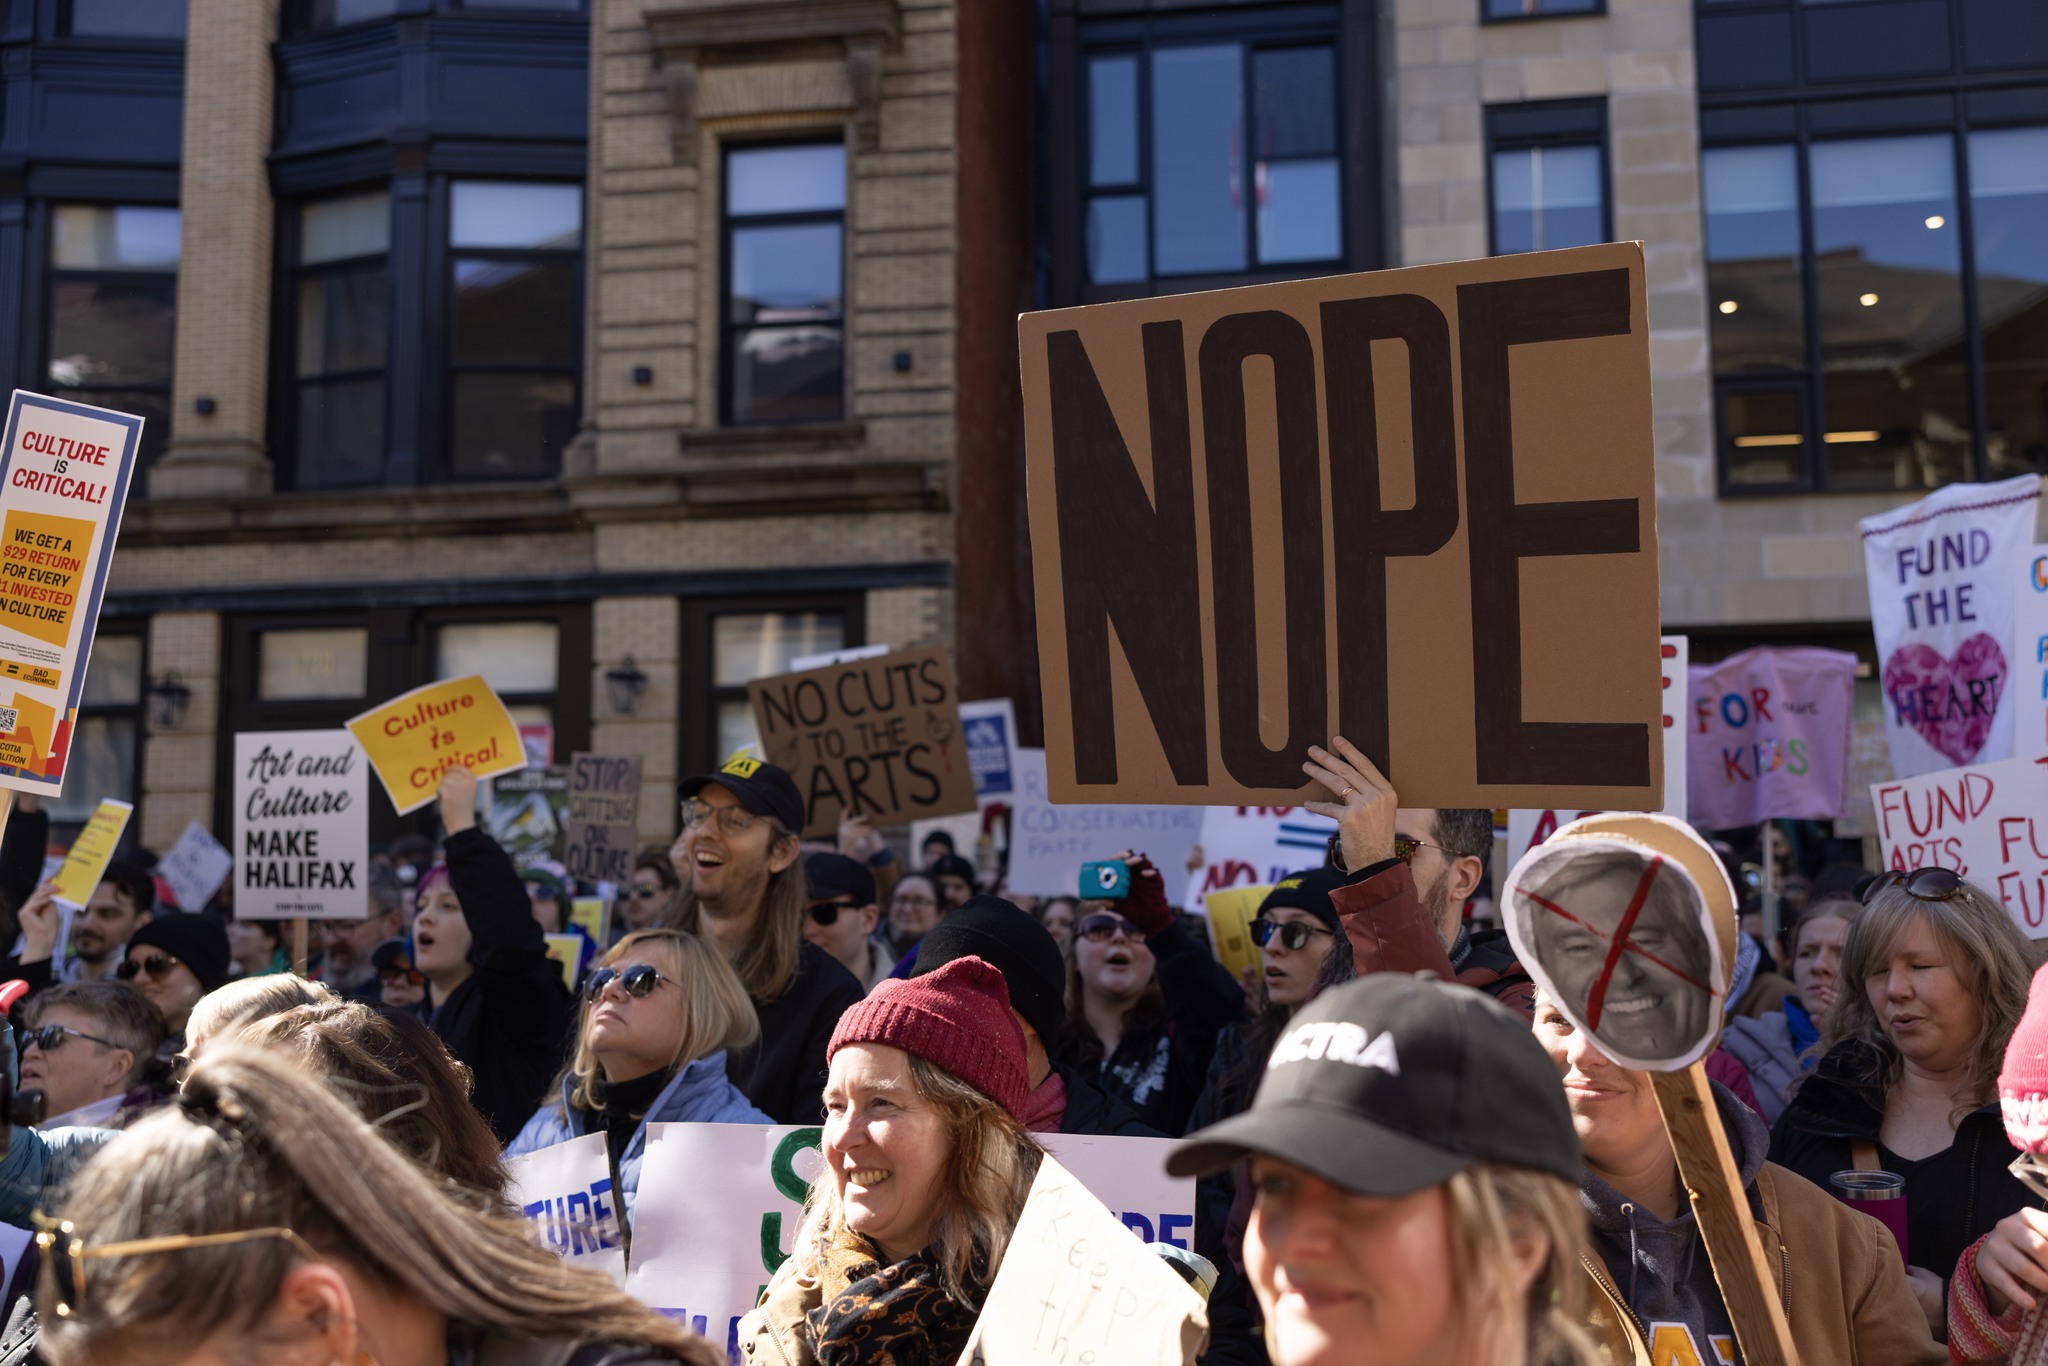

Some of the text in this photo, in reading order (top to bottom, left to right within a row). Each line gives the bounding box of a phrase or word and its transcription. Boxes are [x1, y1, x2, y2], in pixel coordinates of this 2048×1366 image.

[22, 431, 110, 466] CULTURE
[53, 459, 68, 474] IS
[12, 468, 107, 504] CRITICAL!
[14, 528, 72, 553] WE GET A
[1046, 267, 1651, 790] NOPE
[3, 544, 81, 572] $29 RETURN
[1896, 528, 1991, 585] FUND
[0, 578, 73, 607] 1 INVESTED
[2, 562, 71, 588] FOR EVERY
[0, 597, 67, 624] N CULTURE
[1904, 584, 1977, 630] THE
[22, 674, 57, 686] ECONOMICS
[33, 668, 49, 678] BAD
[760, 658, 947, 733] NO CUTS
[1695, 687, 1775, 734] FOR
[1891, 675, 1999, 727] HEART
[384, 694, 475, 737] Culture
[0, 743, 21, 753] COTIA
[430, 725, 456, 750] is
[807, 716, 910, 760] TO THE
[247, 744, 356, 784] Art and
[574, 757, 631, 792] STOP
[1722, 738, 1809, 784] KIDS
[806, 743, 942, 827] ARTS
[246, 785, 353, 822] Culture
[1020, 806, 1195, 834] CONSERVATIVE
[1879, 773, 1994, 840] FUND
[246, 830, 319, 858] MAKE
[245, 860, 356, 889] HALIFAX
[523, 1177, 621, 1256] TURE
